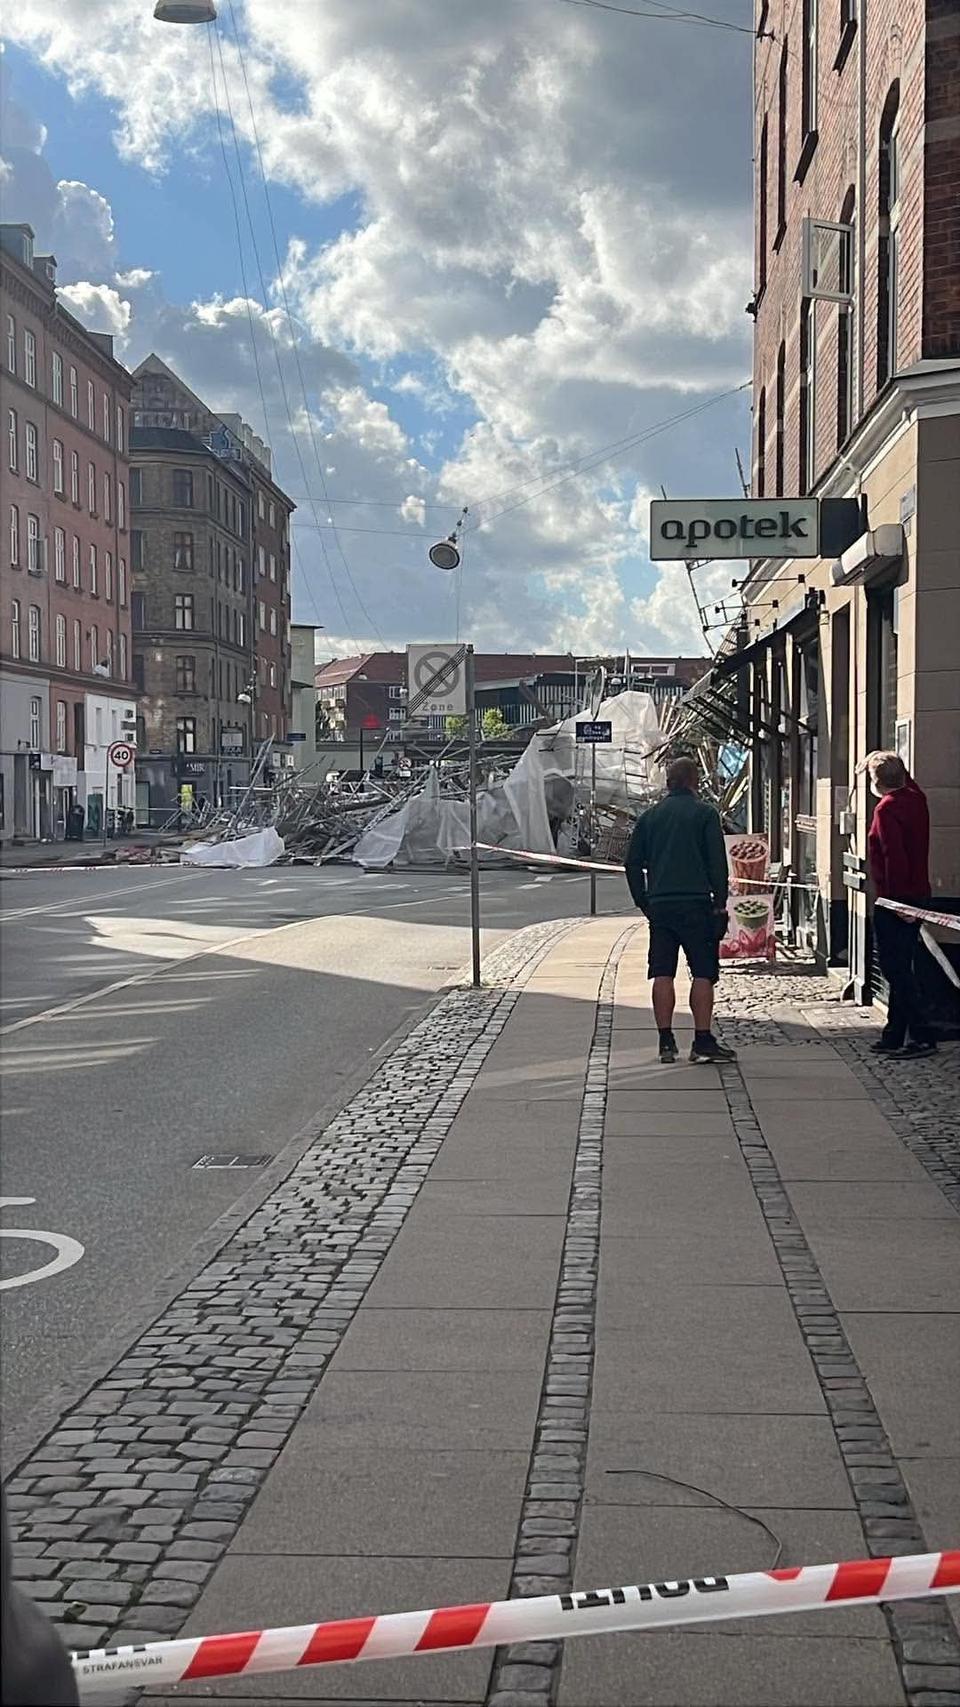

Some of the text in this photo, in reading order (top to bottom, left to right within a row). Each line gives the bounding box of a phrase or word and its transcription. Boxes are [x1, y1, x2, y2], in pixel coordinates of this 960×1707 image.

[661, 511, 809, 548] apotek
[422, 702, 454, 711] Zone
[114, 751, 129, 760] 40
